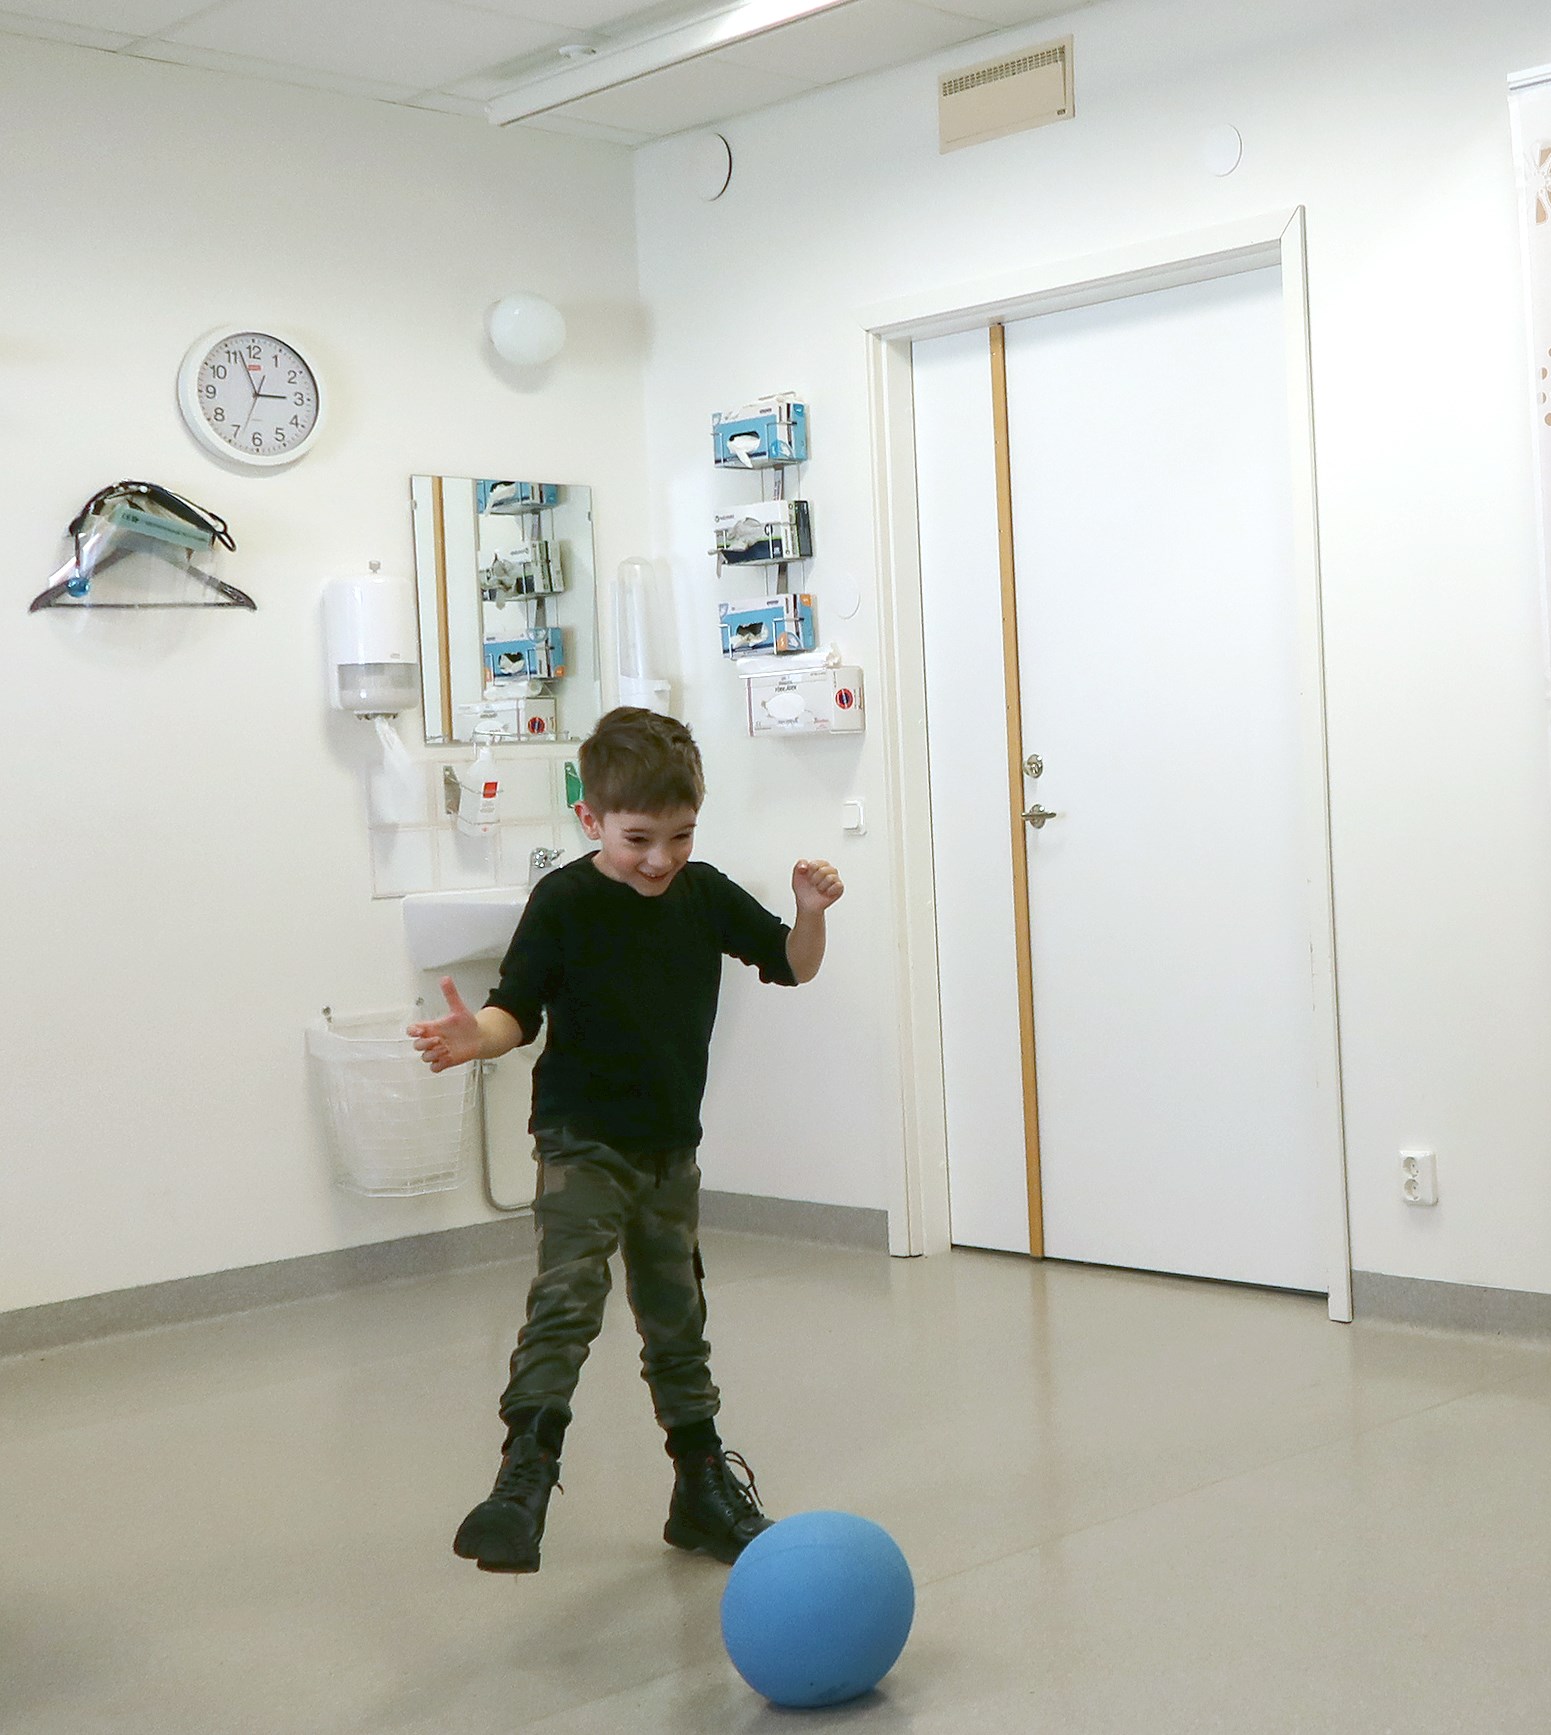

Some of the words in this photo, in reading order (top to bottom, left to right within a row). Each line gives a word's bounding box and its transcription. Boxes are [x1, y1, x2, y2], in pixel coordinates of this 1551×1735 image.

[225, 351, 238, 364] 11
[246, 345, 262, 360] 12
[272, 355, 279, 368] 1
[210, 365, 227, 379] 10
[287, 370, 297, 384] 2
[205, 385, 217, 399] 9
[293, 392, 304, 406] 3
[213, 407, 225, 422] 8
[289, 415, 299, 429] 4
[231, 425, 241, 438] 7
[274, 428, 285, 442] 5
[252, 432, 263, 447] 6
